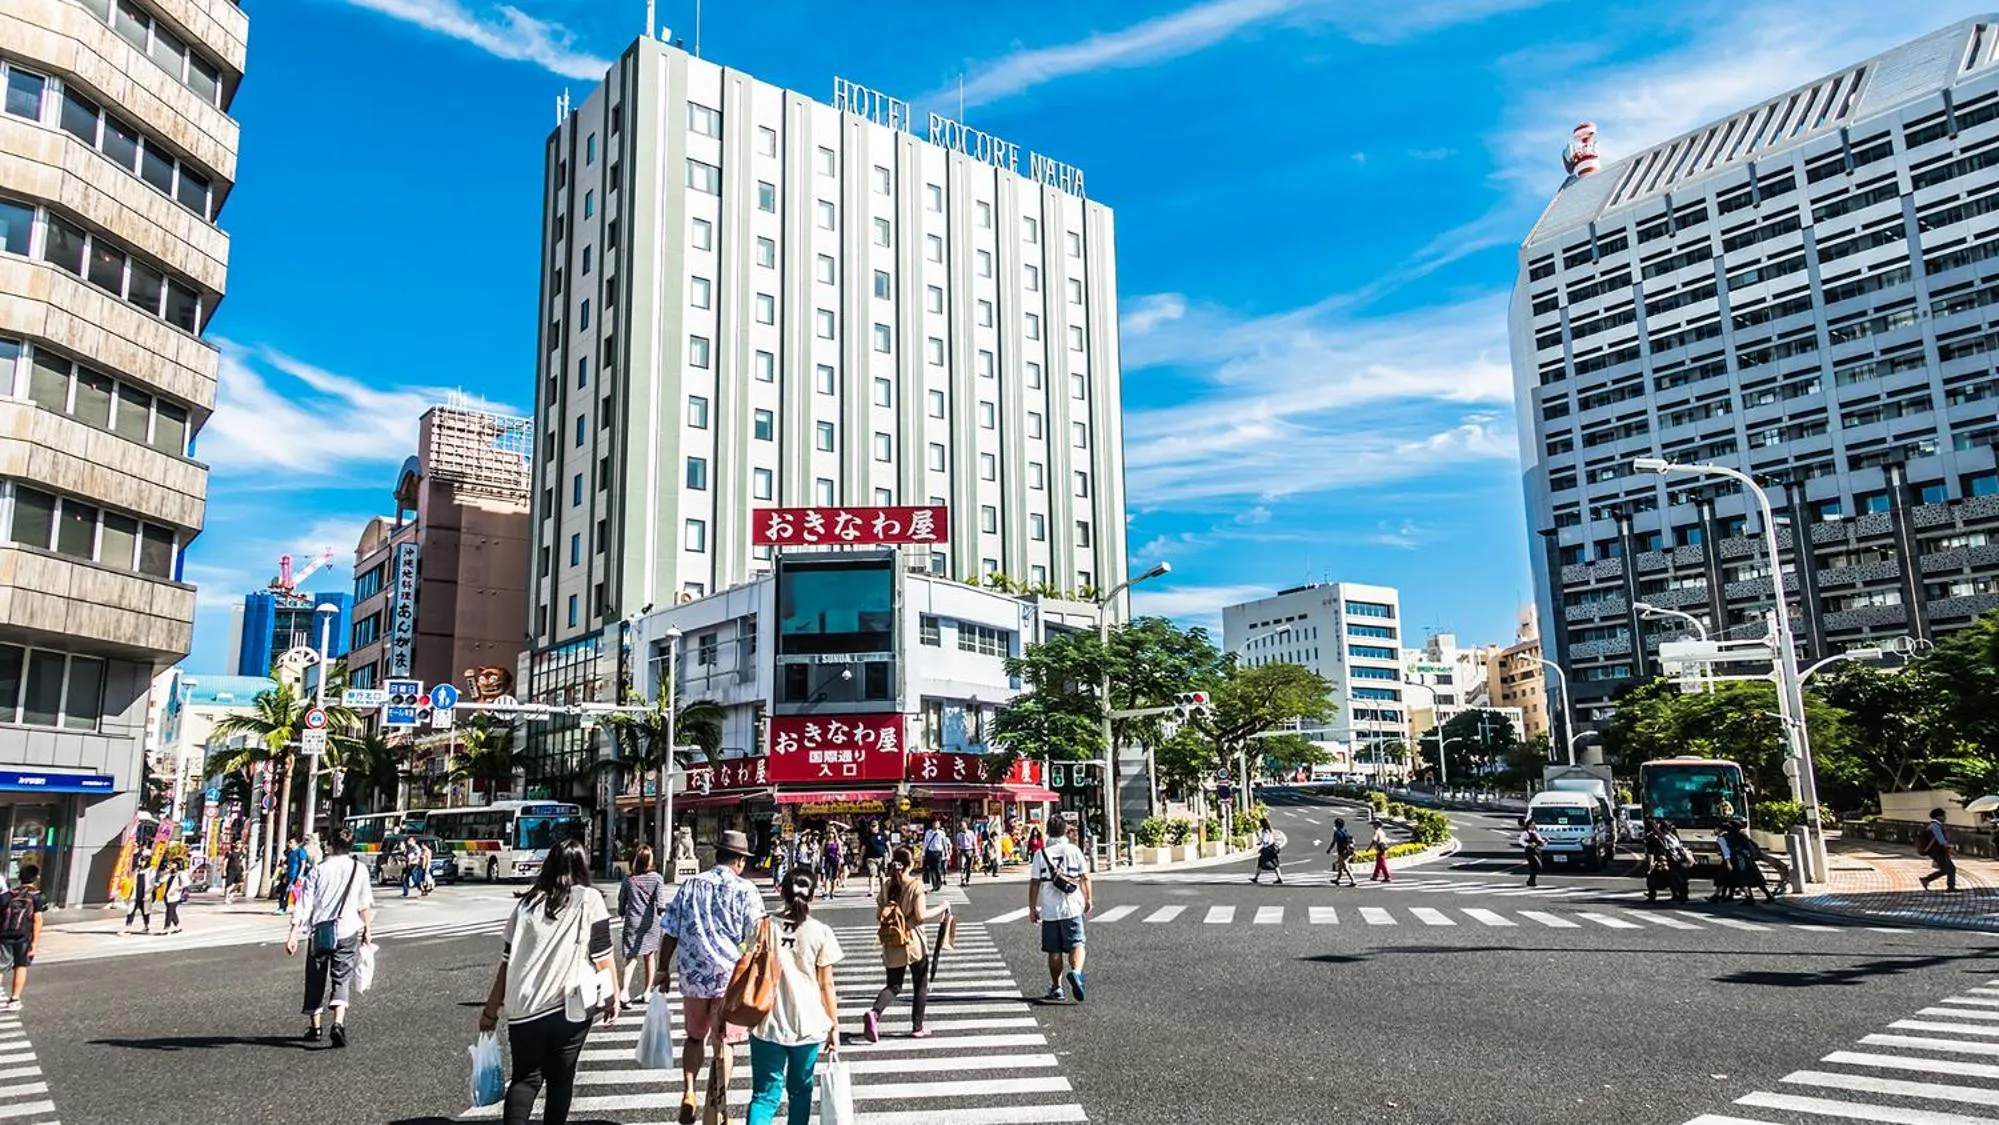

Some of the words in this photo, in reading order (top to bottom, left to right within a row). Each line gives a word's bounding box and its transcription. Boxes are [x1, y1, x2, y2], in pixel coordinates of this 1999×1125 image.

[832, 75, 910, 133] HOTEL
[928, 111, 1021, 173] ROCORE
[1029, 150, 1086, 199] NAHA
[765, 509, 937, 541] おきなわ屋
[774, 719, 900, 756] おきなわ屋
[808, 749, 866, 764] 国際通り
[818, 763, 857, 777] 入口
[921, 756, 1033, 783] おきな屋
